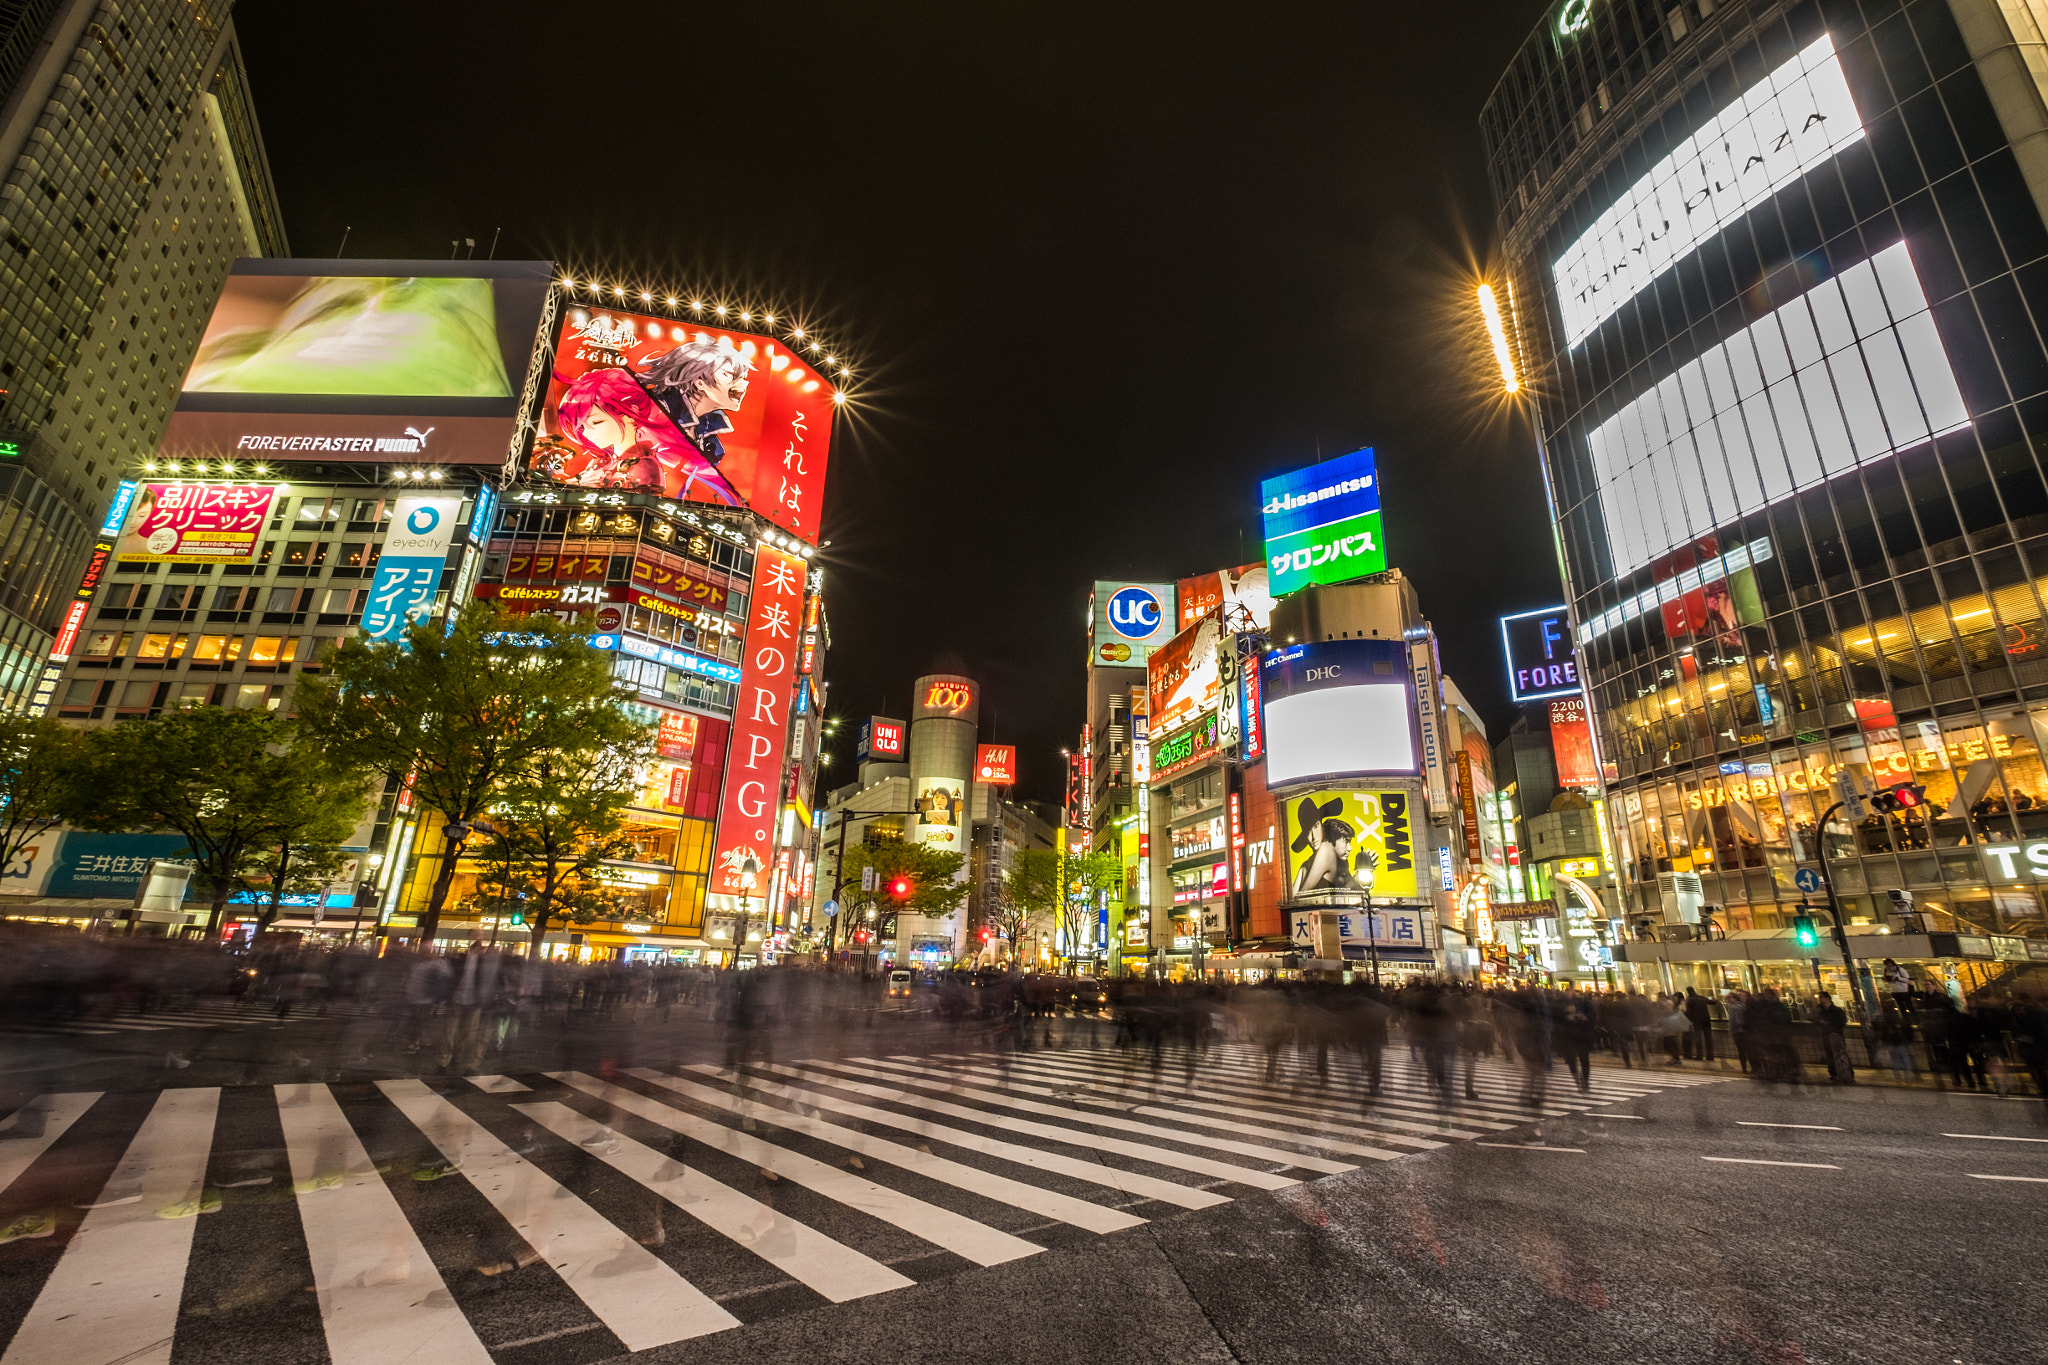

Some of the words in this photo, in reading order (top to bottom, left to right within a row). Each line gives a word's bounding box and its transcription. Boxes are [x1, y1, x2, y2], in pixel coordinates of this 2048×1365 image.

[574, 346, 628, 367] ZERO
[237, 435, 371, 451] FOREVERFASTER
[156, 487, 270, 510] 品川スキン
[1263, 474, 1373, 514] Hisamitsu
[151, 509, 262, 531] クリニック
[152, 542, 169, 552] 4F
[392, 537, 443, 551] eyecity
[1271, 531, 1376, 576] サロンパス
[510, 556, 604, 575] プライス
[634, 561, 725, 605] コンタクト
[500, 587, 560, 599] Caféレストラン
[561, 586, 609, 603] ガスト
[1184, 593, 1217, 608] 天上の
[365, 568, 410, 650] アイシ
[638, 595, 694, 622] Caféレストラン
[695, 611, 736, 637] ガスト
[599, 617, 619, 625] ガスト
[1100, 648, 1131, 656] MasterCard
[1277, 650, 1304, 664] Channel
[1306, 664, 1342, 682] DHC
[1517, 662, 1577, 690] FORE
[934, 682, 969, 691] SHIBUYA
[1416, 662, 1434, 717] Taisei
[737, 560, 798, 841] 未来のRPG。
[925, 687, 970, 714] 109
[1551, 700, 1584, 712] 2200
[1552, 711, 1585, 723] 渋谷。
[877, 726, 897, 738] UNI
[876, 738, 898, 750] QLO
[1422, 721, 1437, 769] neon
[985, 749, 1007, 764] H&M
[1689, 763, 1845, 810] STARBUCKS
[1866, 735, 2013, 776] COFFEE
[1071, 754, 1079, 824] KATE
[1459, 753, 1474, 815] クスリのことなら
[1353, 792, 1382, 844] FX
[1380, 793, 1412, 872] DMM
[1465, 819, 1481, 859] 三千里
[1173, 841, 1210, 858] Euphoria
[1986, 843, 2048, 879] TS
[73, 874, 111, 882] SUMITOMO
[111, 875, 135, 883] MITSUI
[1296, 916, 1414, 940] 大堂書店
